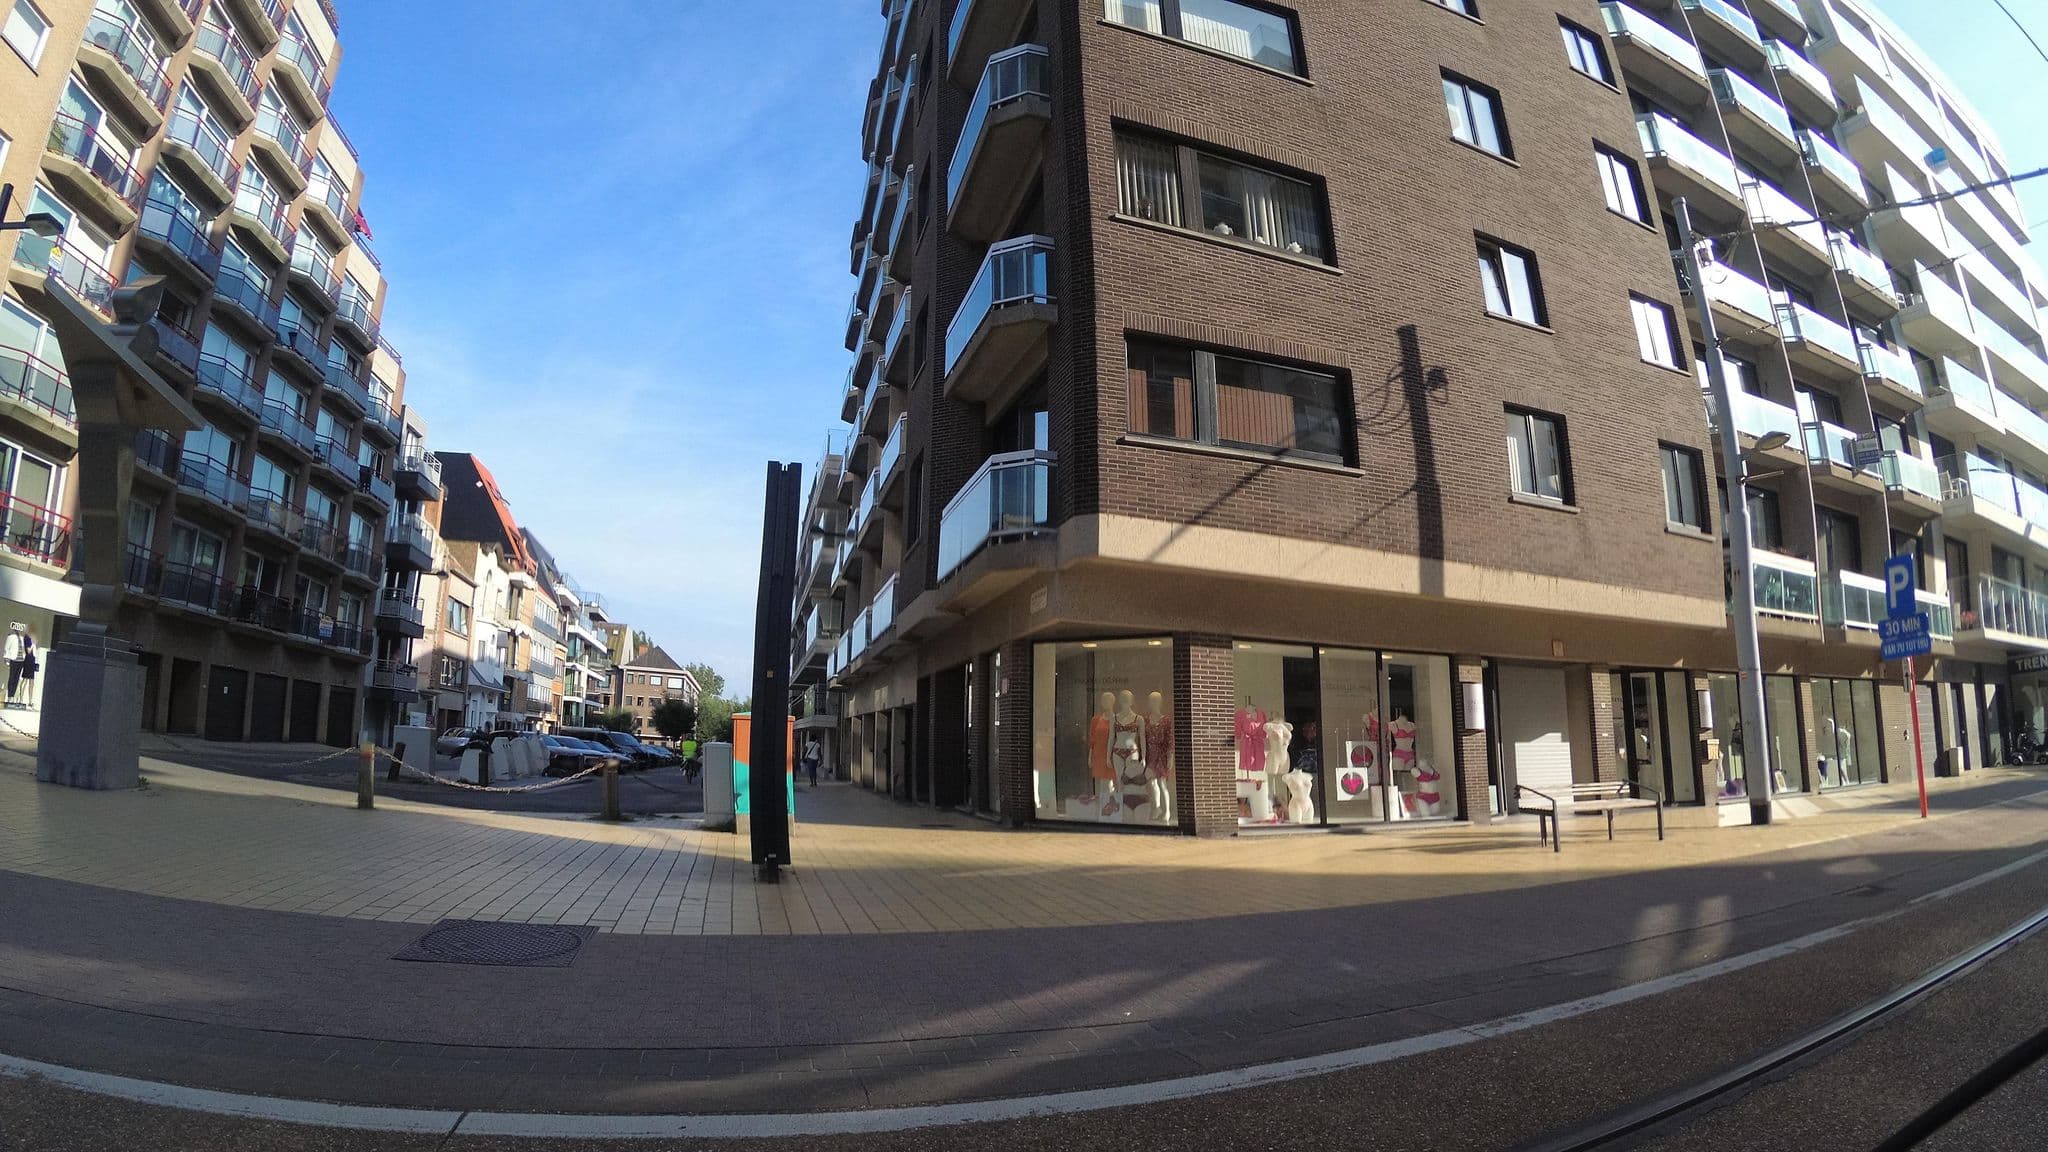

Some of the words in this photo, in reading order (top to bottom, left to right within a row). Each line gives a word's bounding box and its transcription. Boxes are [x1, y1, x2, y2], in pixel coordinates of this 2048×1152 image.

[1888, 565, 1909, 608] P
[1885, 620, 1900, 636] 30
[1901, 615, 1921, 633] MIN
